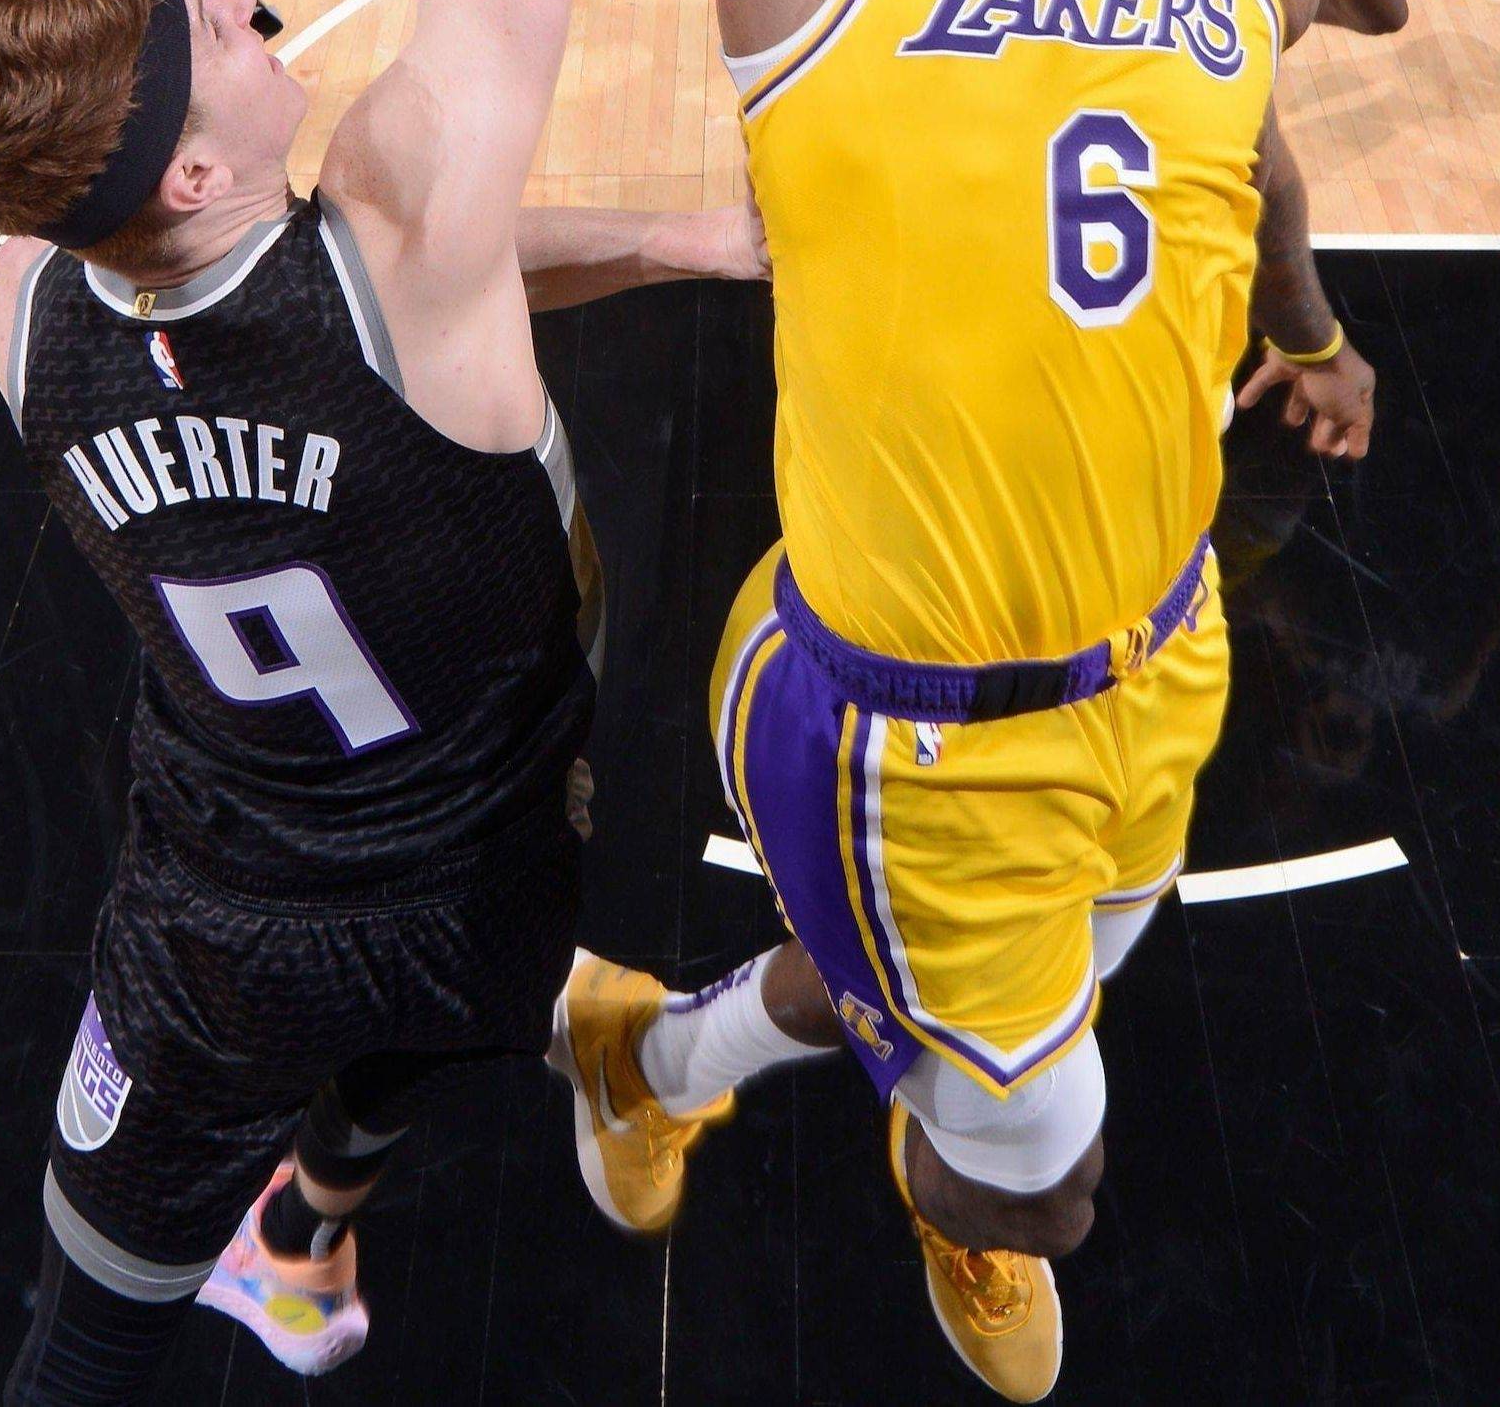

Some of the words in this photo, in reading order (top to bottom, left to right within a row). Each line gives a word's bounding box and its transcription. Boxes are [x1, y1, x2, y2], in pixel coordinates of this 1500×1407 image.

[1047, 108, 1158, 329] 6
[63, 415, 341, 532] HUERTER
[150, 560, 421, 758] 9
